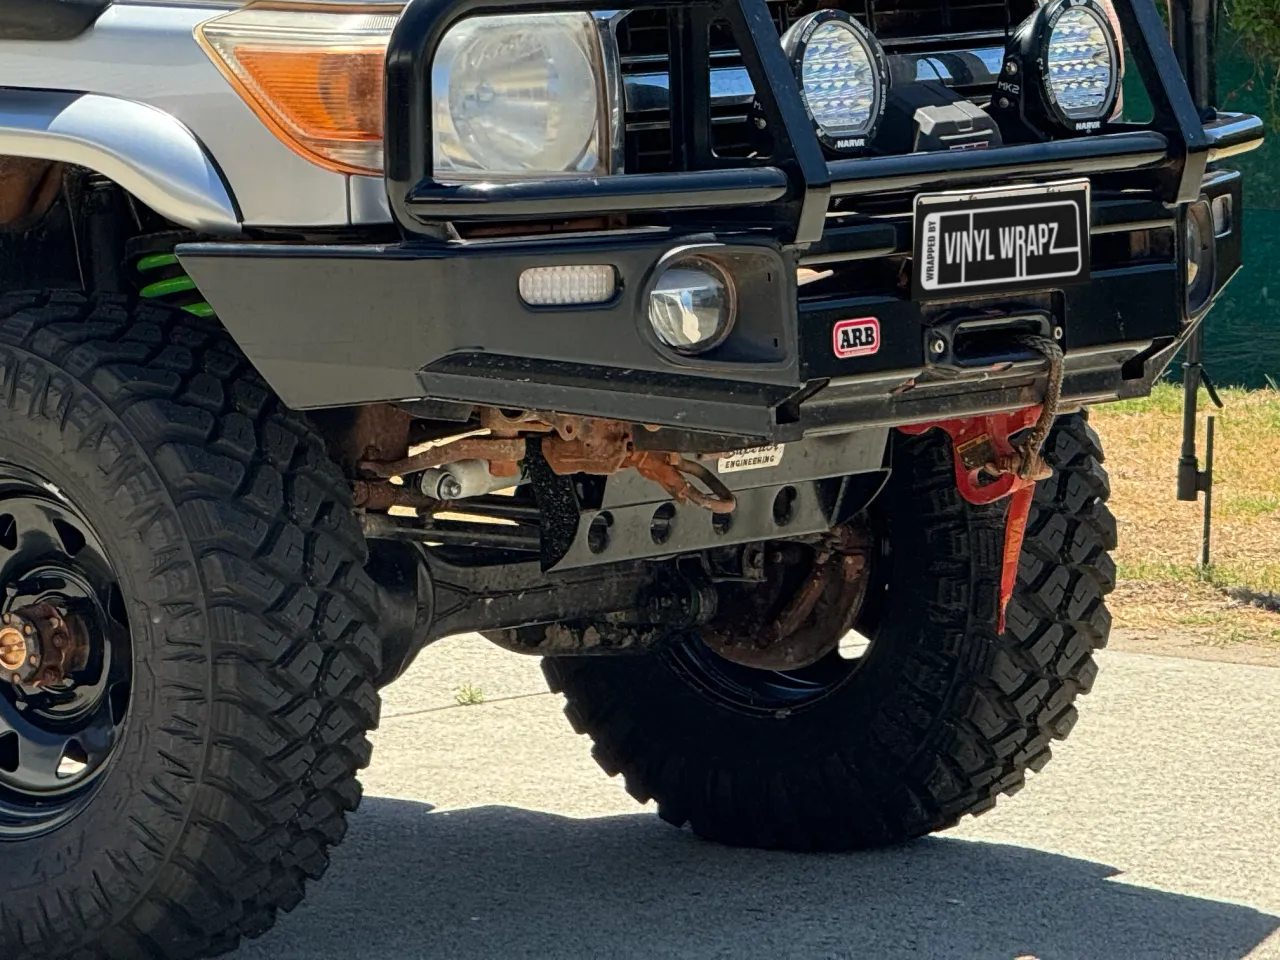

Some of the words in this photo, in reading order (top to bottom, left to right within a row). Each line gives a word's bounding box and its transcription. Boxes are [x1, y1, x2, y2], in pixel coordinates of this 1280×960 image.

[997, 81, 1020, 95] MK2
[837, 138, 865, 149] NARVA
[927, 221, 937, 233] BY
[944, 228, 995, 265] VINYL
[999, 222, 1059, 262] WRAPZ
[925, 235, 937, 281] WRAPPED
[841, 326, 876, 350] ARB
[725, 455, 775, 469] ENGINEERING
